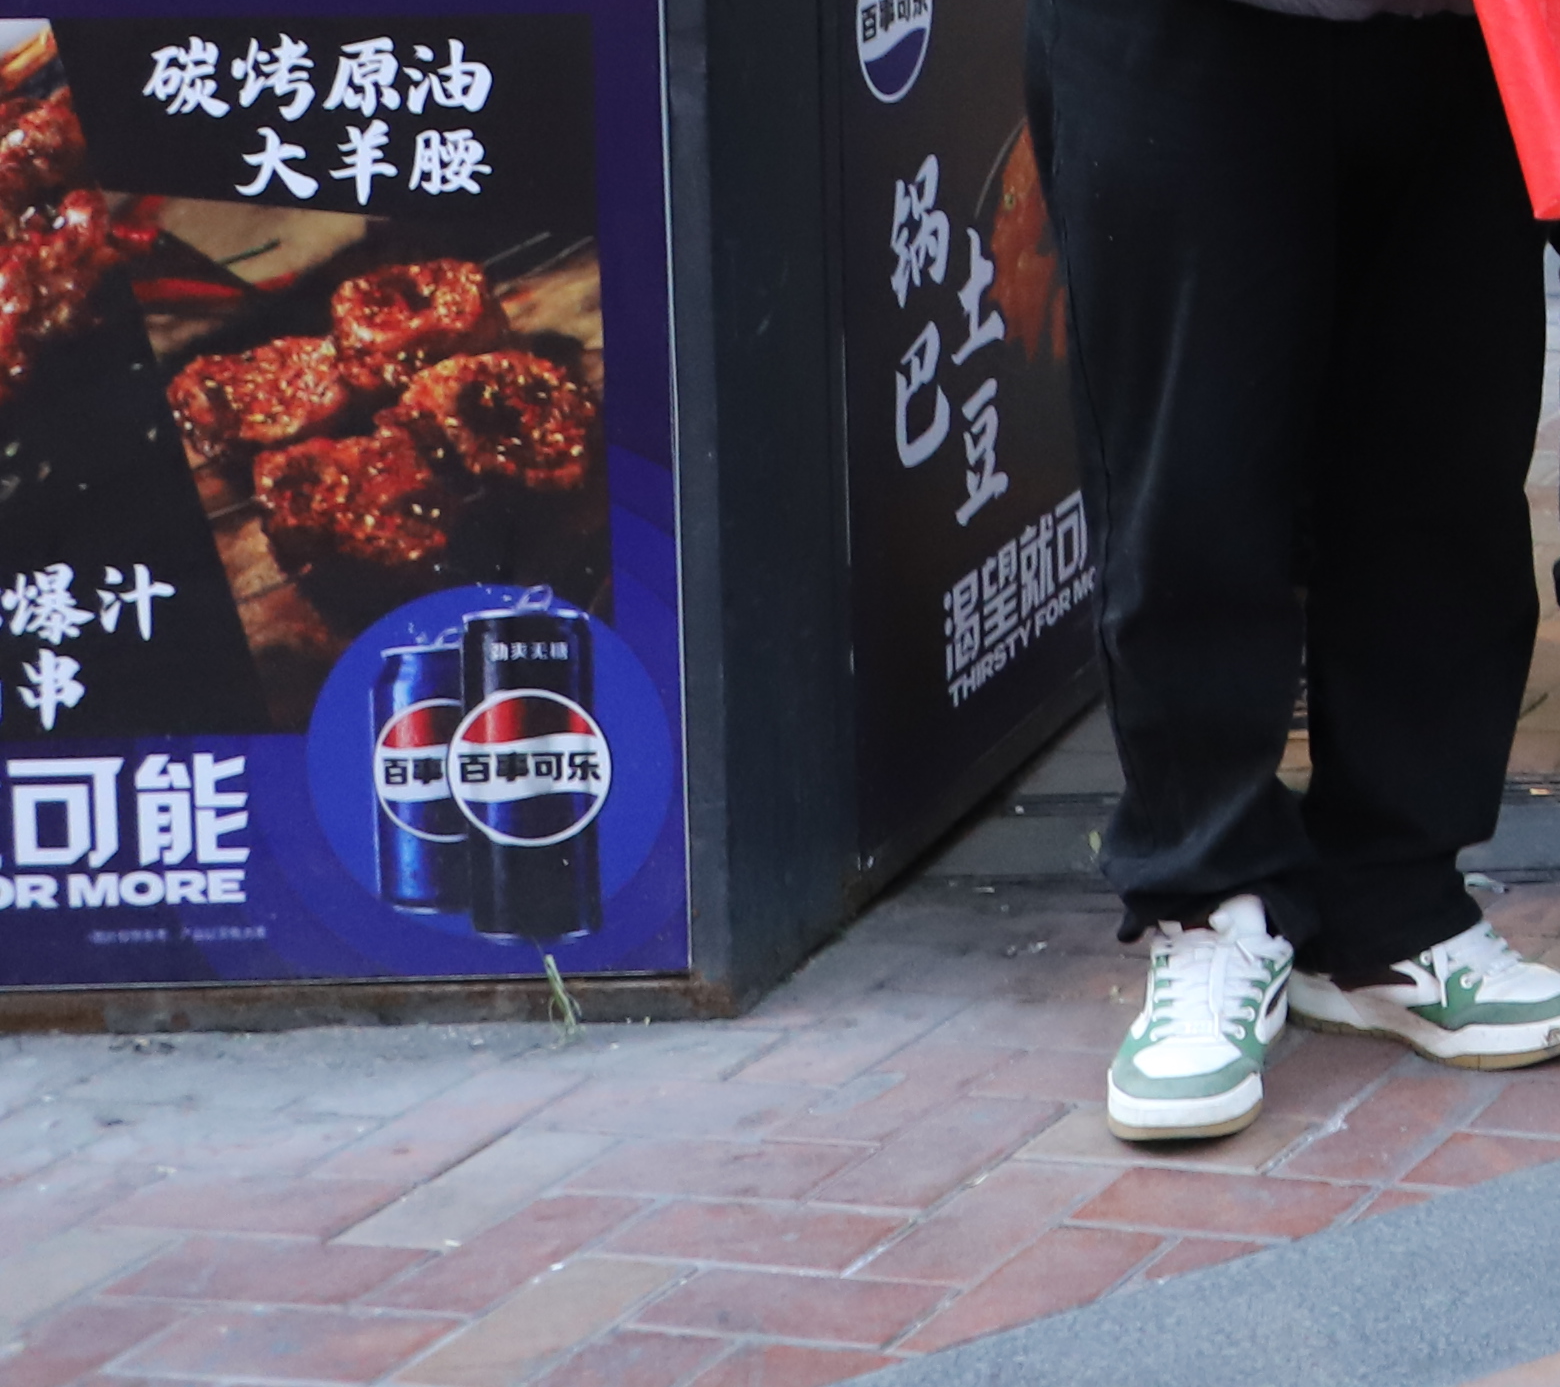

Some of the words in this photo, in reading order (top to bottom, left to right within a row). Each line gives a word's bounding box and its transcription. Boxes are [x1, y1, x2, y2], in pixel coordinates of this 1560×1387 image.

[142, 33, 494, 121] 碳烤原油
[235, 120, 493, 206] 大羊腰
[889, 153, 949, 469] 锅巴
[951, 227, 1010, 527] 土豆
[0, 563, 176, 642] 爆汁
[949, 621, 1032, 708] THIRSTY
[1034, 587, 1071, 638] FOR
[6, 753, 250, 869] 可能
[457, 751, 601, 784] 百事可乐
[68, 869, 246, 909] MORE
